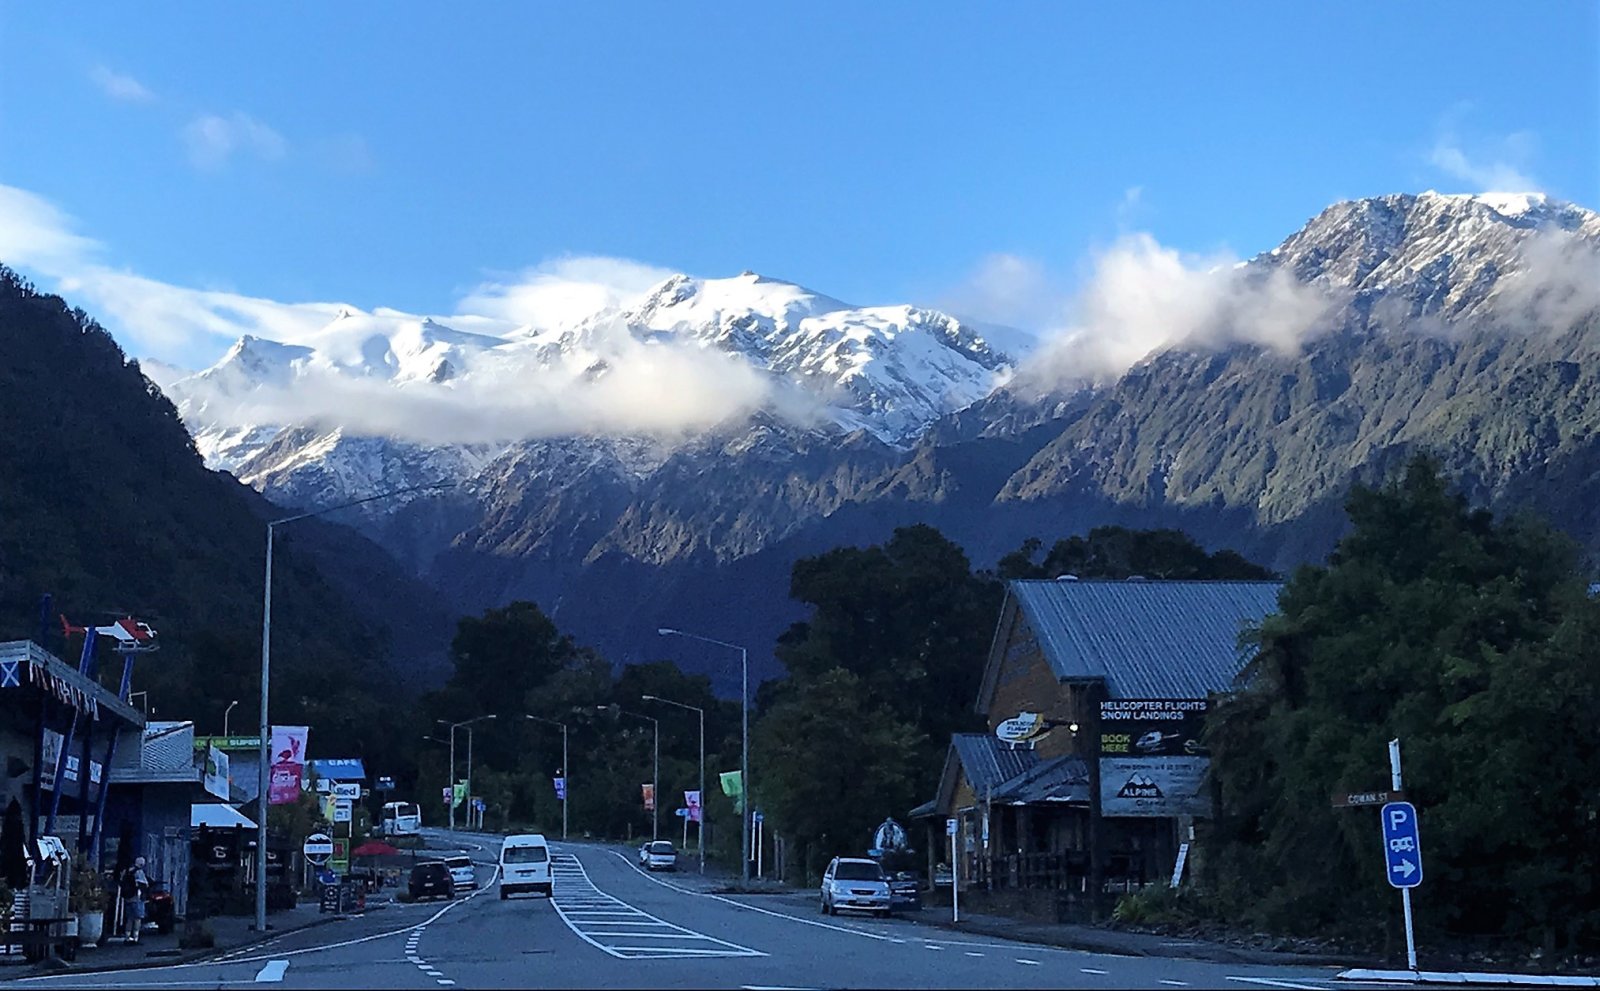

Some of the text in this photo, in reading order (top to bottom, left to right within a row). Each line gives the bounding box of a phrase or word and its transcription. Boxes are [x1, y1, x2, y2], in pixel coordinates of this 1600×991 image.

[1100, 701, 1207, 710] HELICOPTER FLIGHTS
[1100, 711, 1184, 720] SNOW LANDINGS
[229, 739, 261, 747] SUPER
[1101, 734, 1131, 743] BOOK
[1101, 743, 1129, 752] HERE
[1122, 787, 1158, 797] ALPINE
[1379, 792, 1388, 801] ST
[1390, 810, 1407, 830] P
